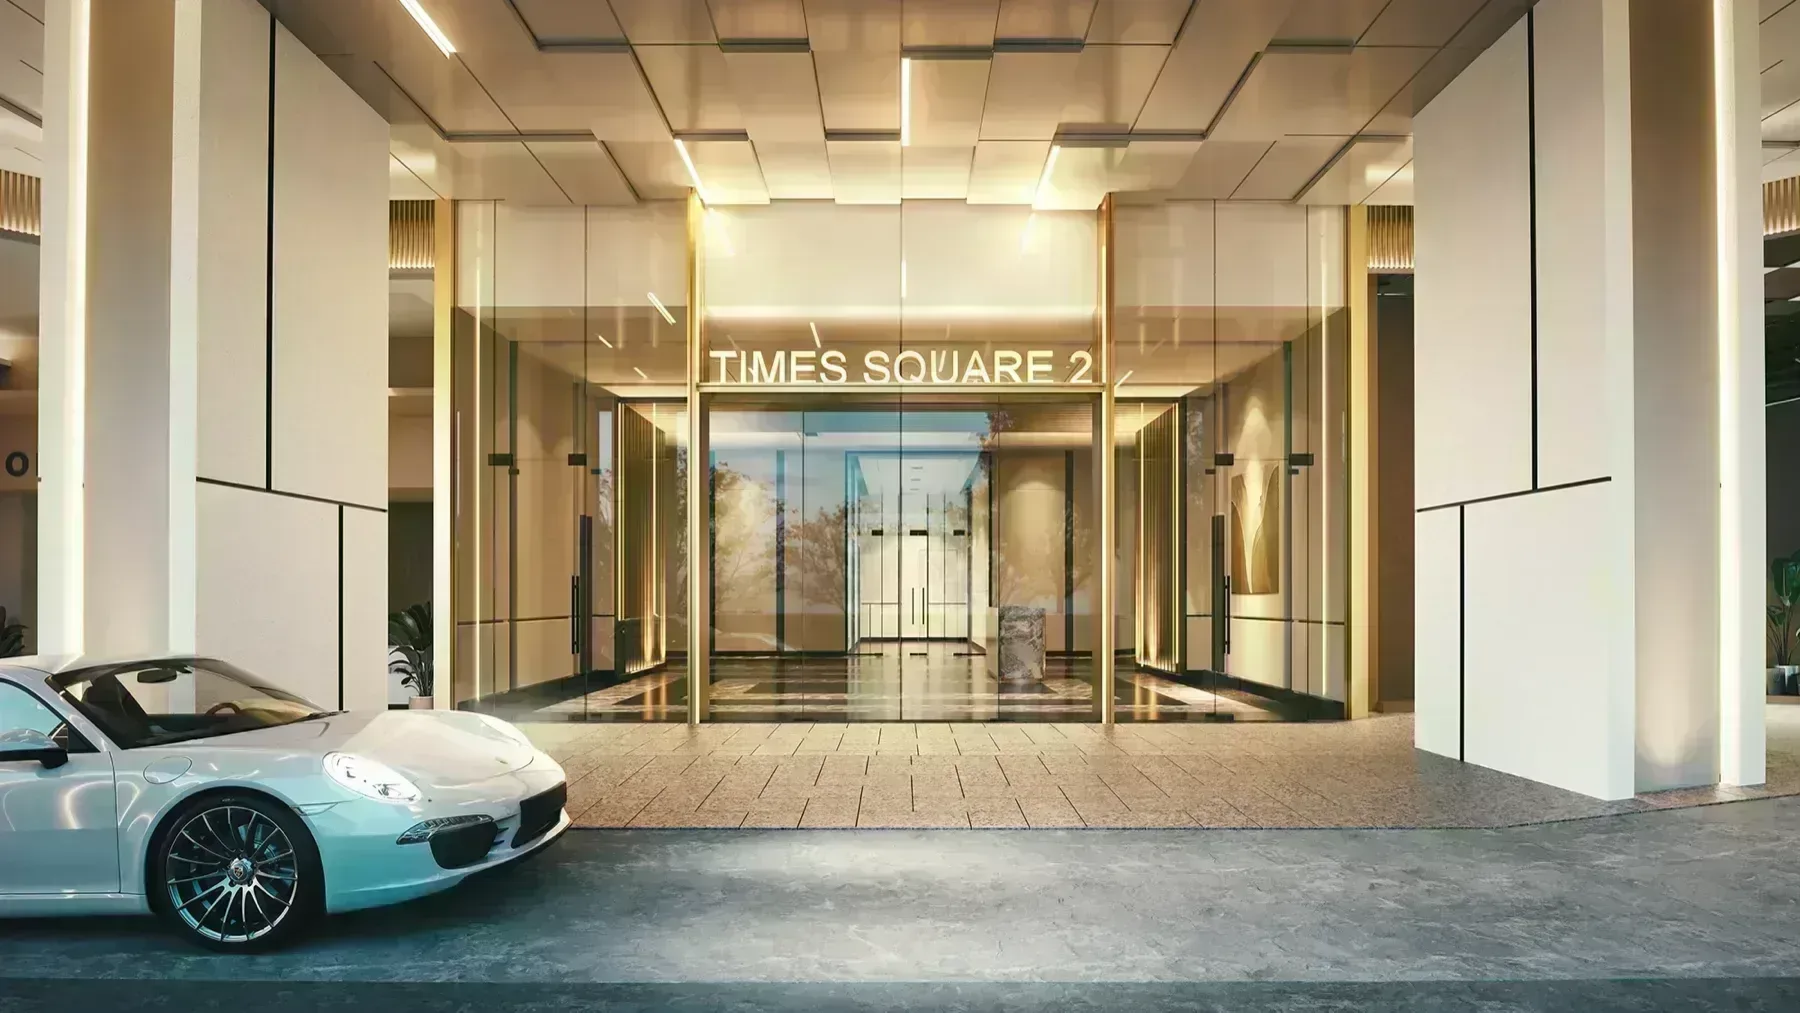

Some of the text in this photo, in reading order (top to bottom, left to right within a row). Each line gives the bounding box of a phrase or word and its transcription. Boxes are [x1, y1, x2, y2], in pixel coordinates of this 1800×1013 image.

[709, 350, 1092, 383] TIMES SQUARE 2
